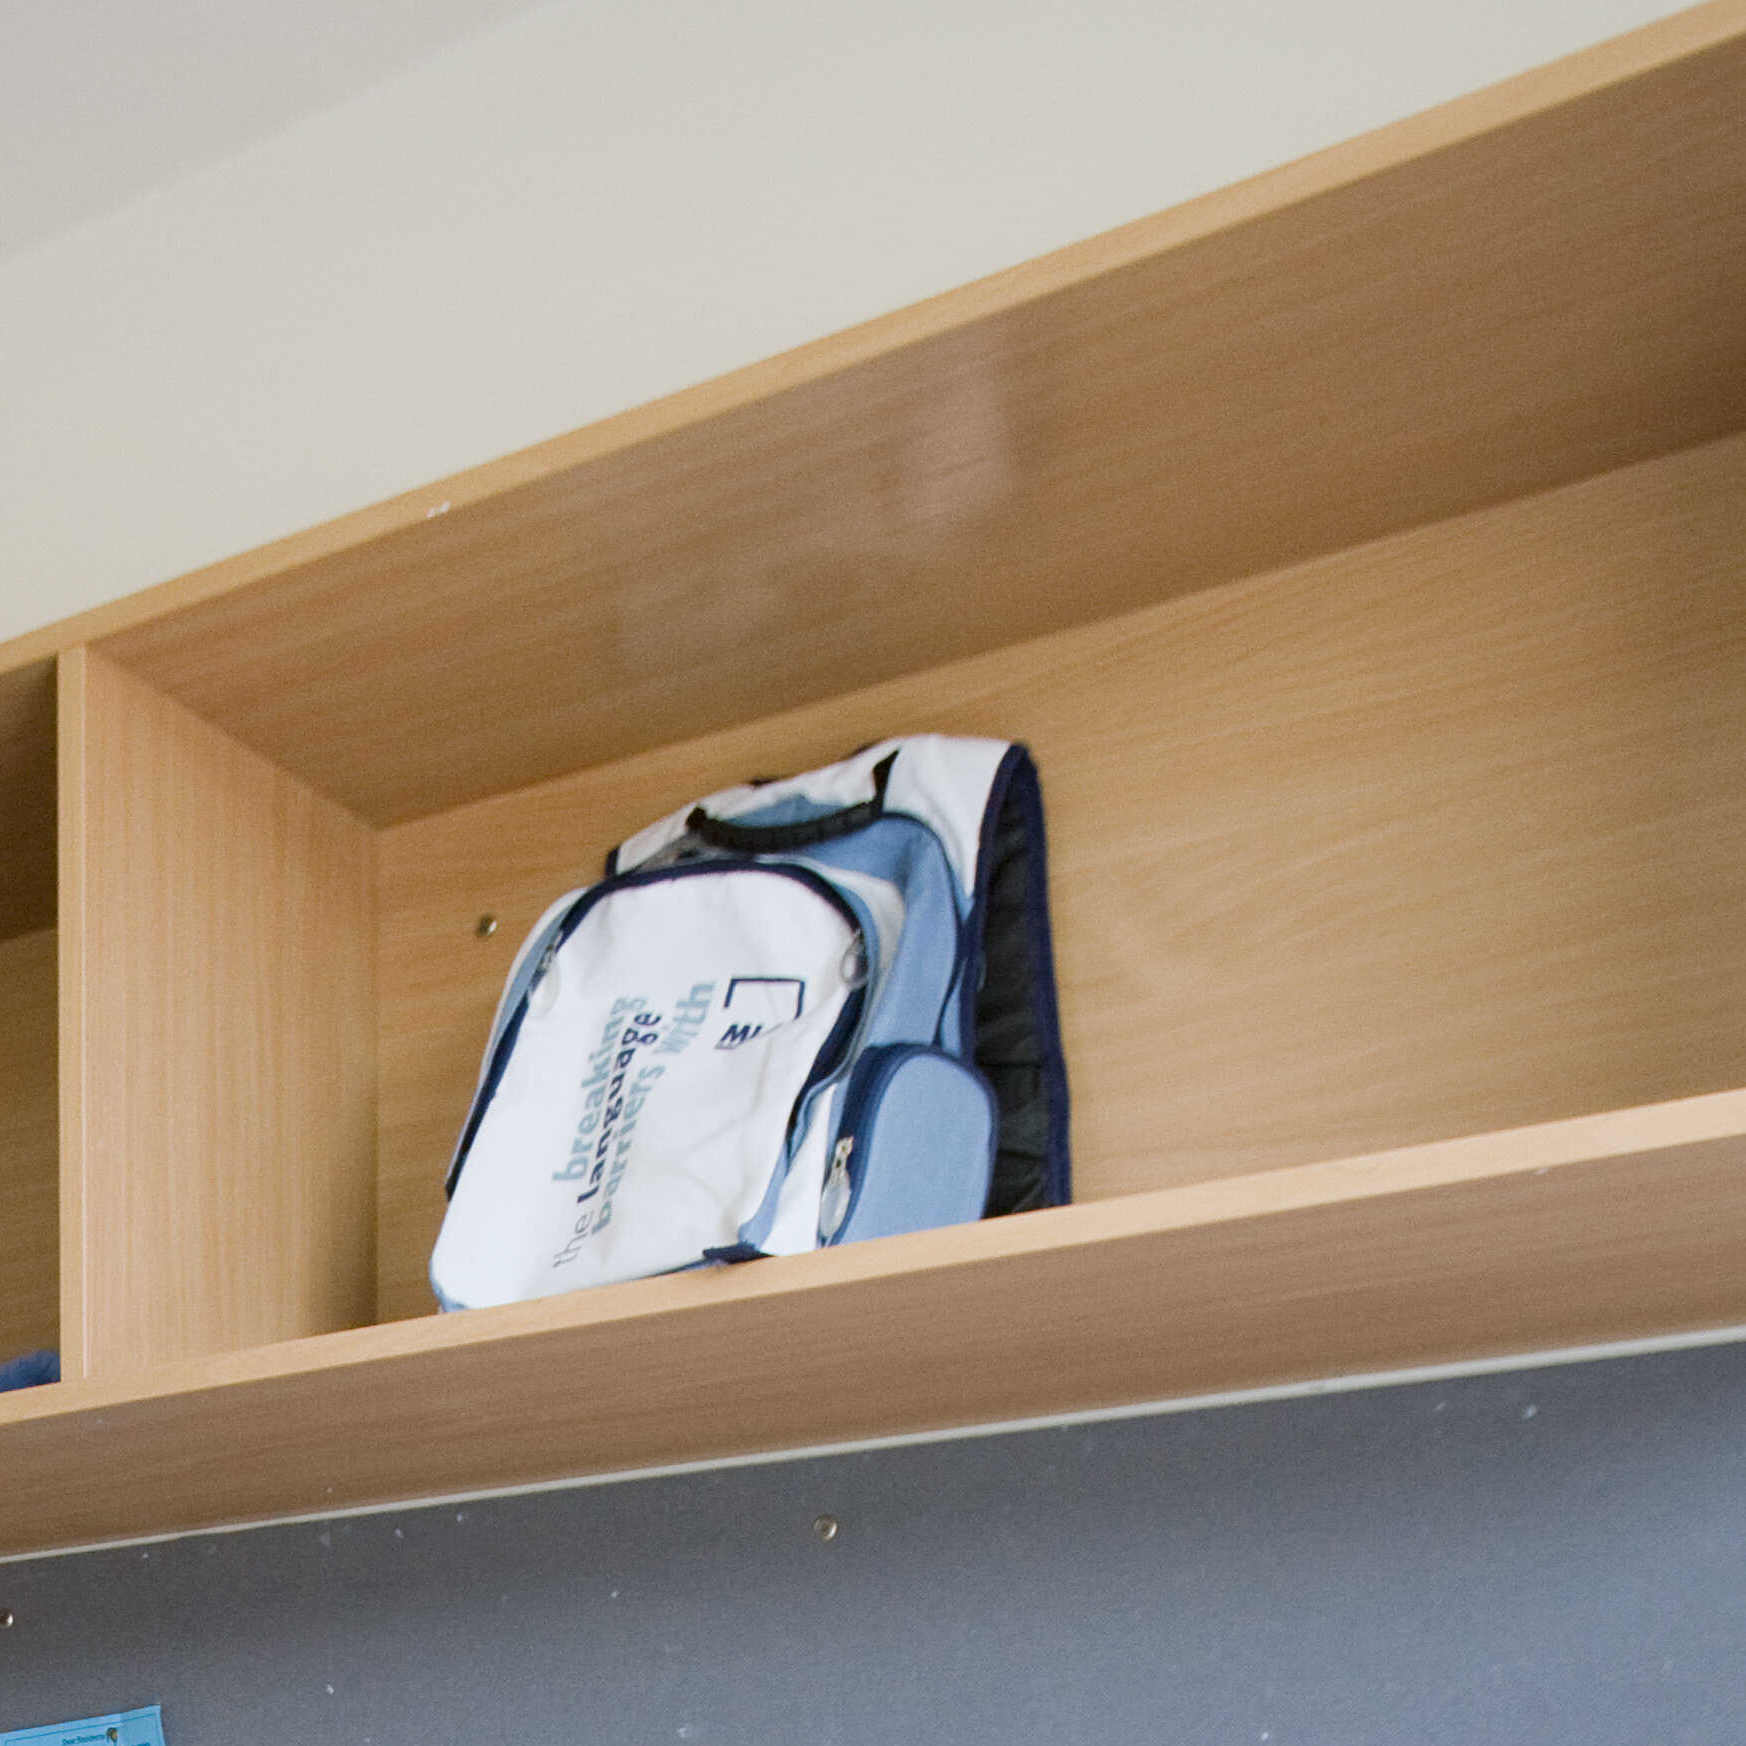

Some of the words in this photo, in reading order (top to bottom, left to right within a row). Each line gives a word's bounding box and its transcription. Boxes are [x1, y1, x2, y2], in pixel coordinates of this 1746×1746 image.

[553, 996, 647, 1181] breaking
[553, 1210, 594, 1268] the
[576, 1011, 662, 1204] language
[591, 1064, 666, 1234] barriers
[652, 981, 715, 1056] with
